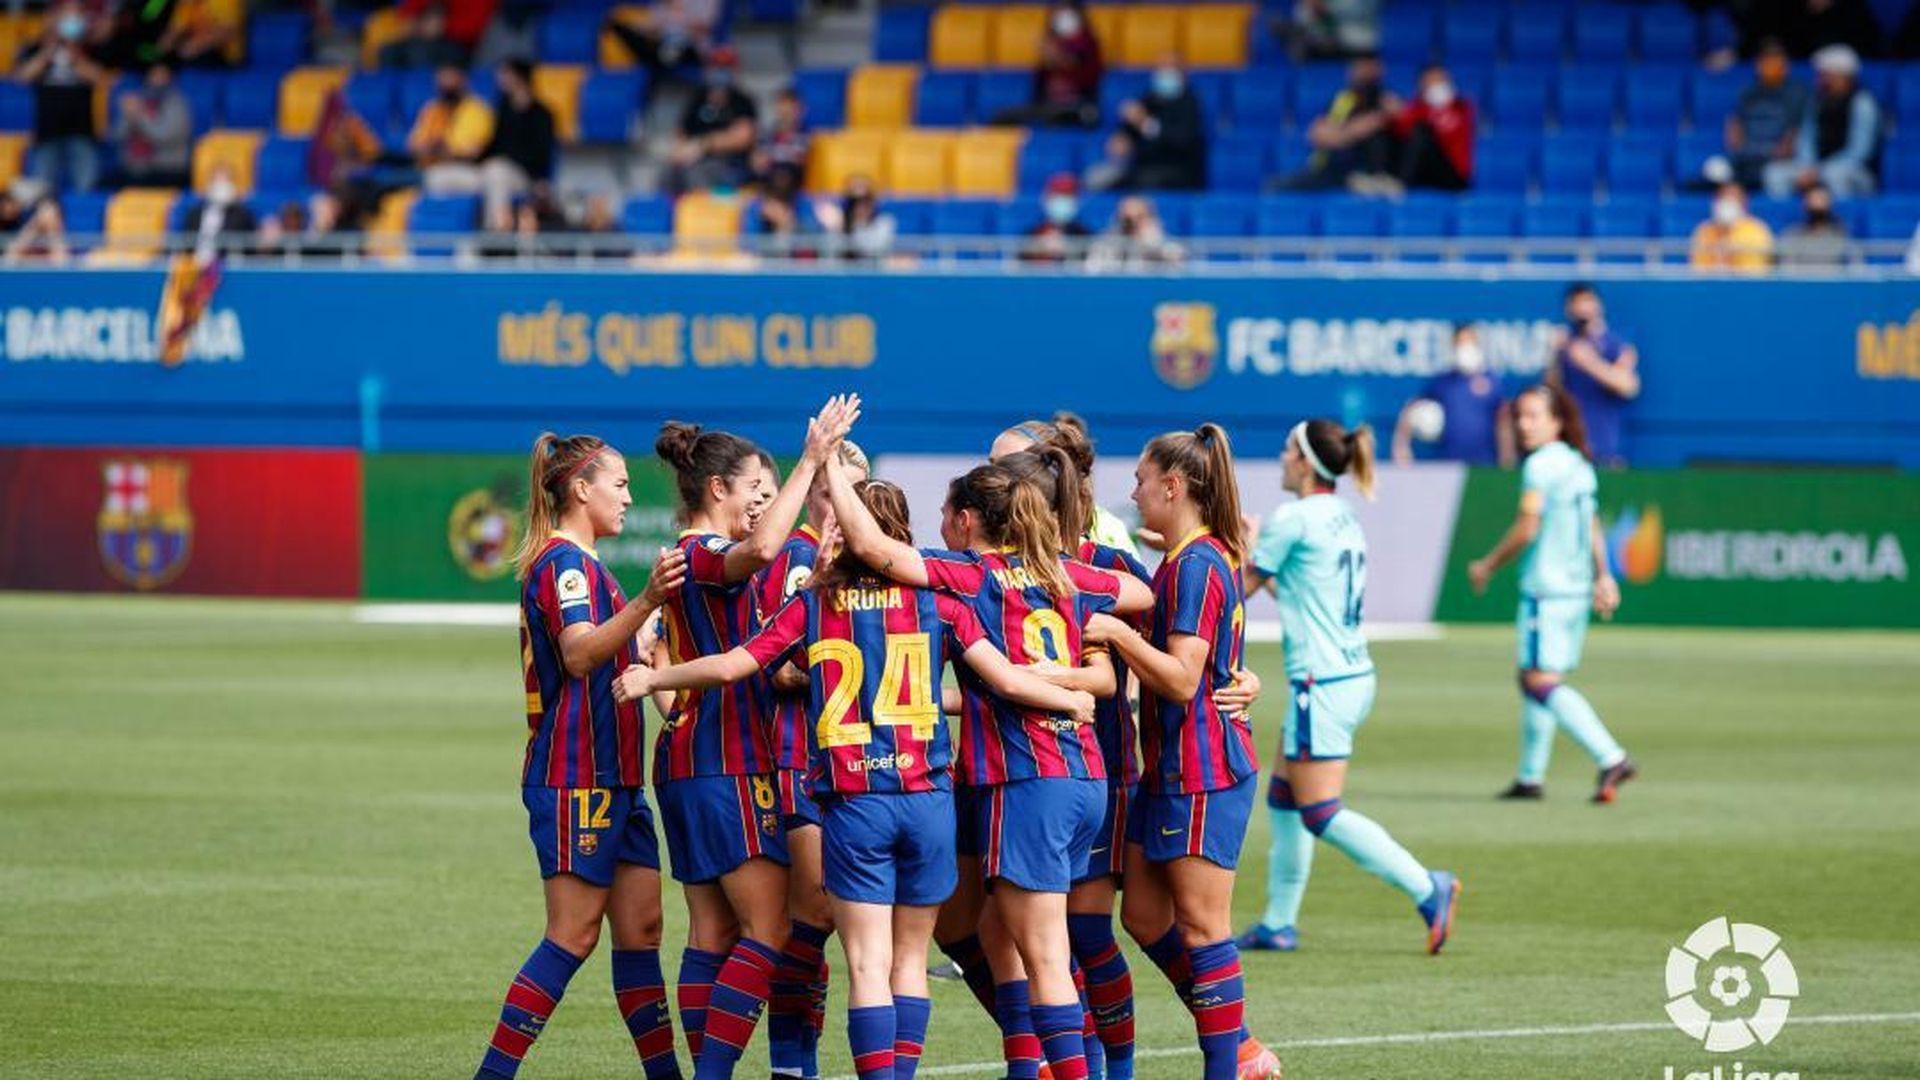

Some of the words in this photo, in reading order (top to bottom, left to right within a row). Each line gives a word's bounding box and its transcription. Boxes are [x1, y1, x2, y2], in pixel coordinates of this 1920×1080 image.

[6, 307, 244, 363] BARCELNA
[498, 300, 592, 366] MÉS
[597, 312, 686, 375] QUE
[690, 314, 757, 368] UN
[761, 312, 877, 369] CLUB
[1227, 318, 1284, 374] FC
[1667, 531, 1908, 582] IBERDROLA
[808, 633, 939, 749] 24
[847, 756, 895, 772] unicef
[572, 788, 611, 828] 12
